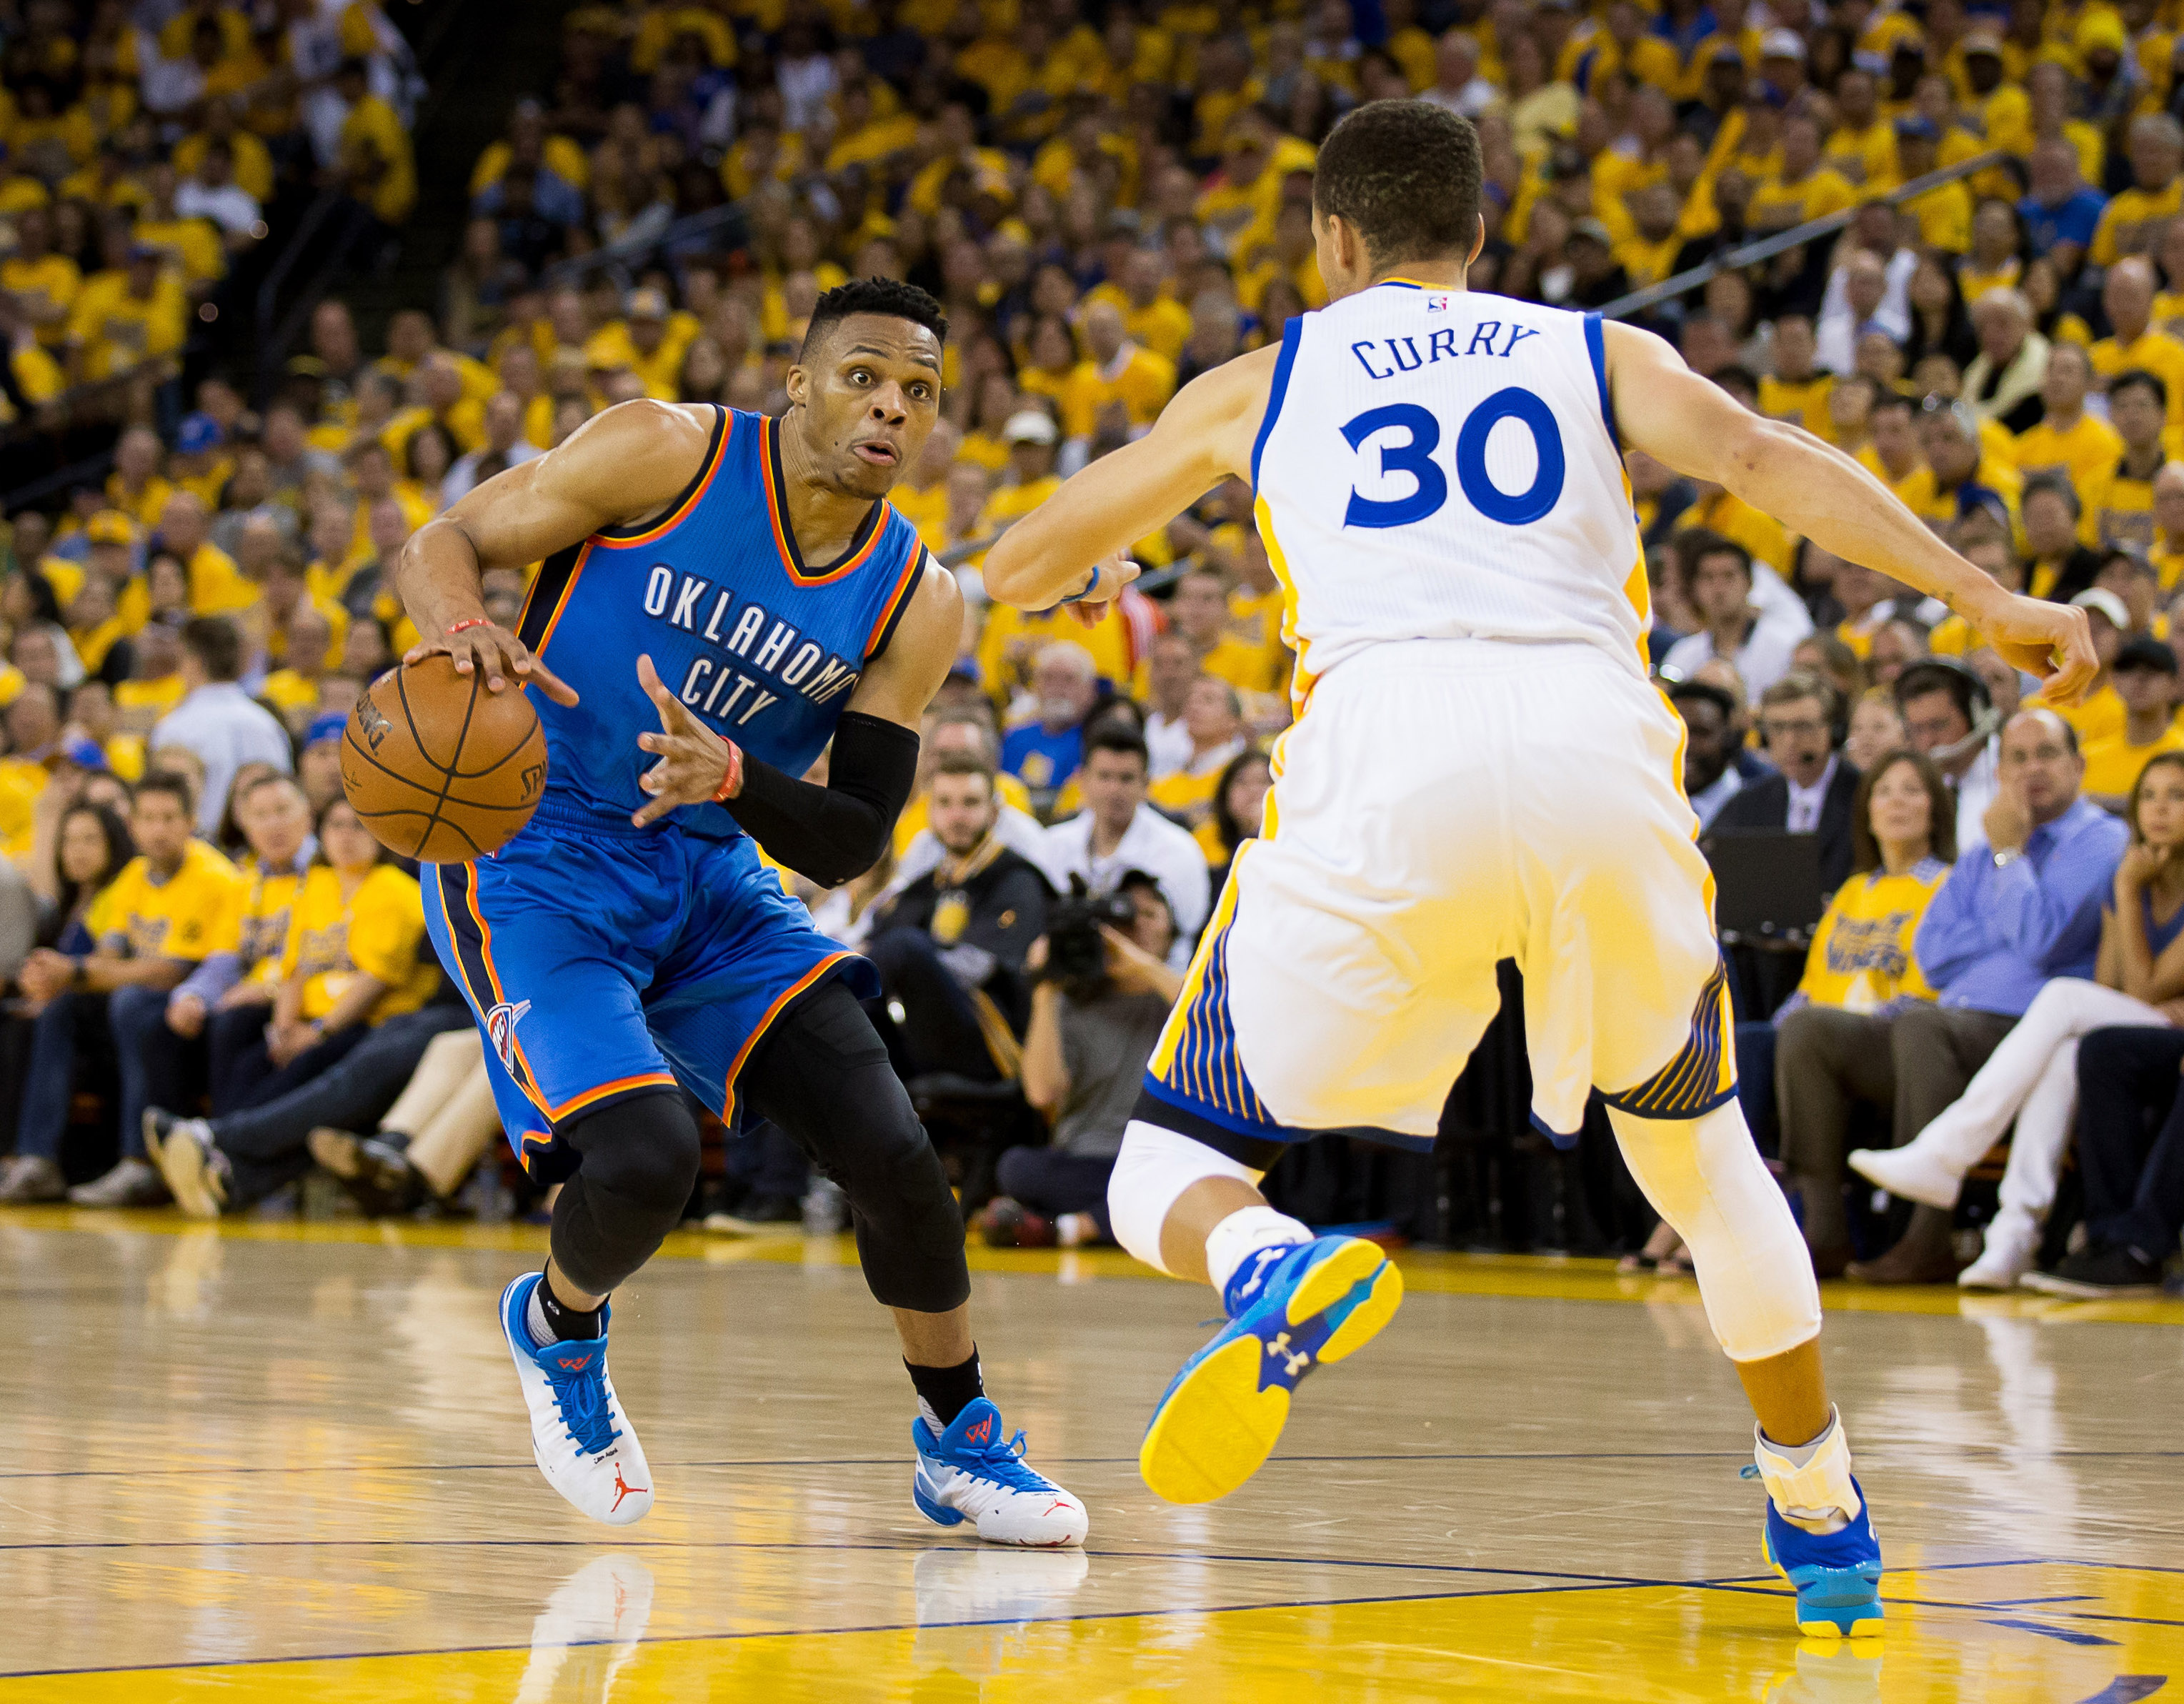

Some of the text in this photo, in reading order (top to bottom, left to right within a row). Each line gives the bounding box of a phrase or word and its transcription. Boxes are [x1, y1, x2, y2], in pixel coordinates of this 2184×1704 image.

[1350, 321, 1540, 379] CURRY
[1338, 387, 1565, 531] 30
[644, 564, 859, 705] OKLAHOMA
[681, 656, 779, 726] CITY
